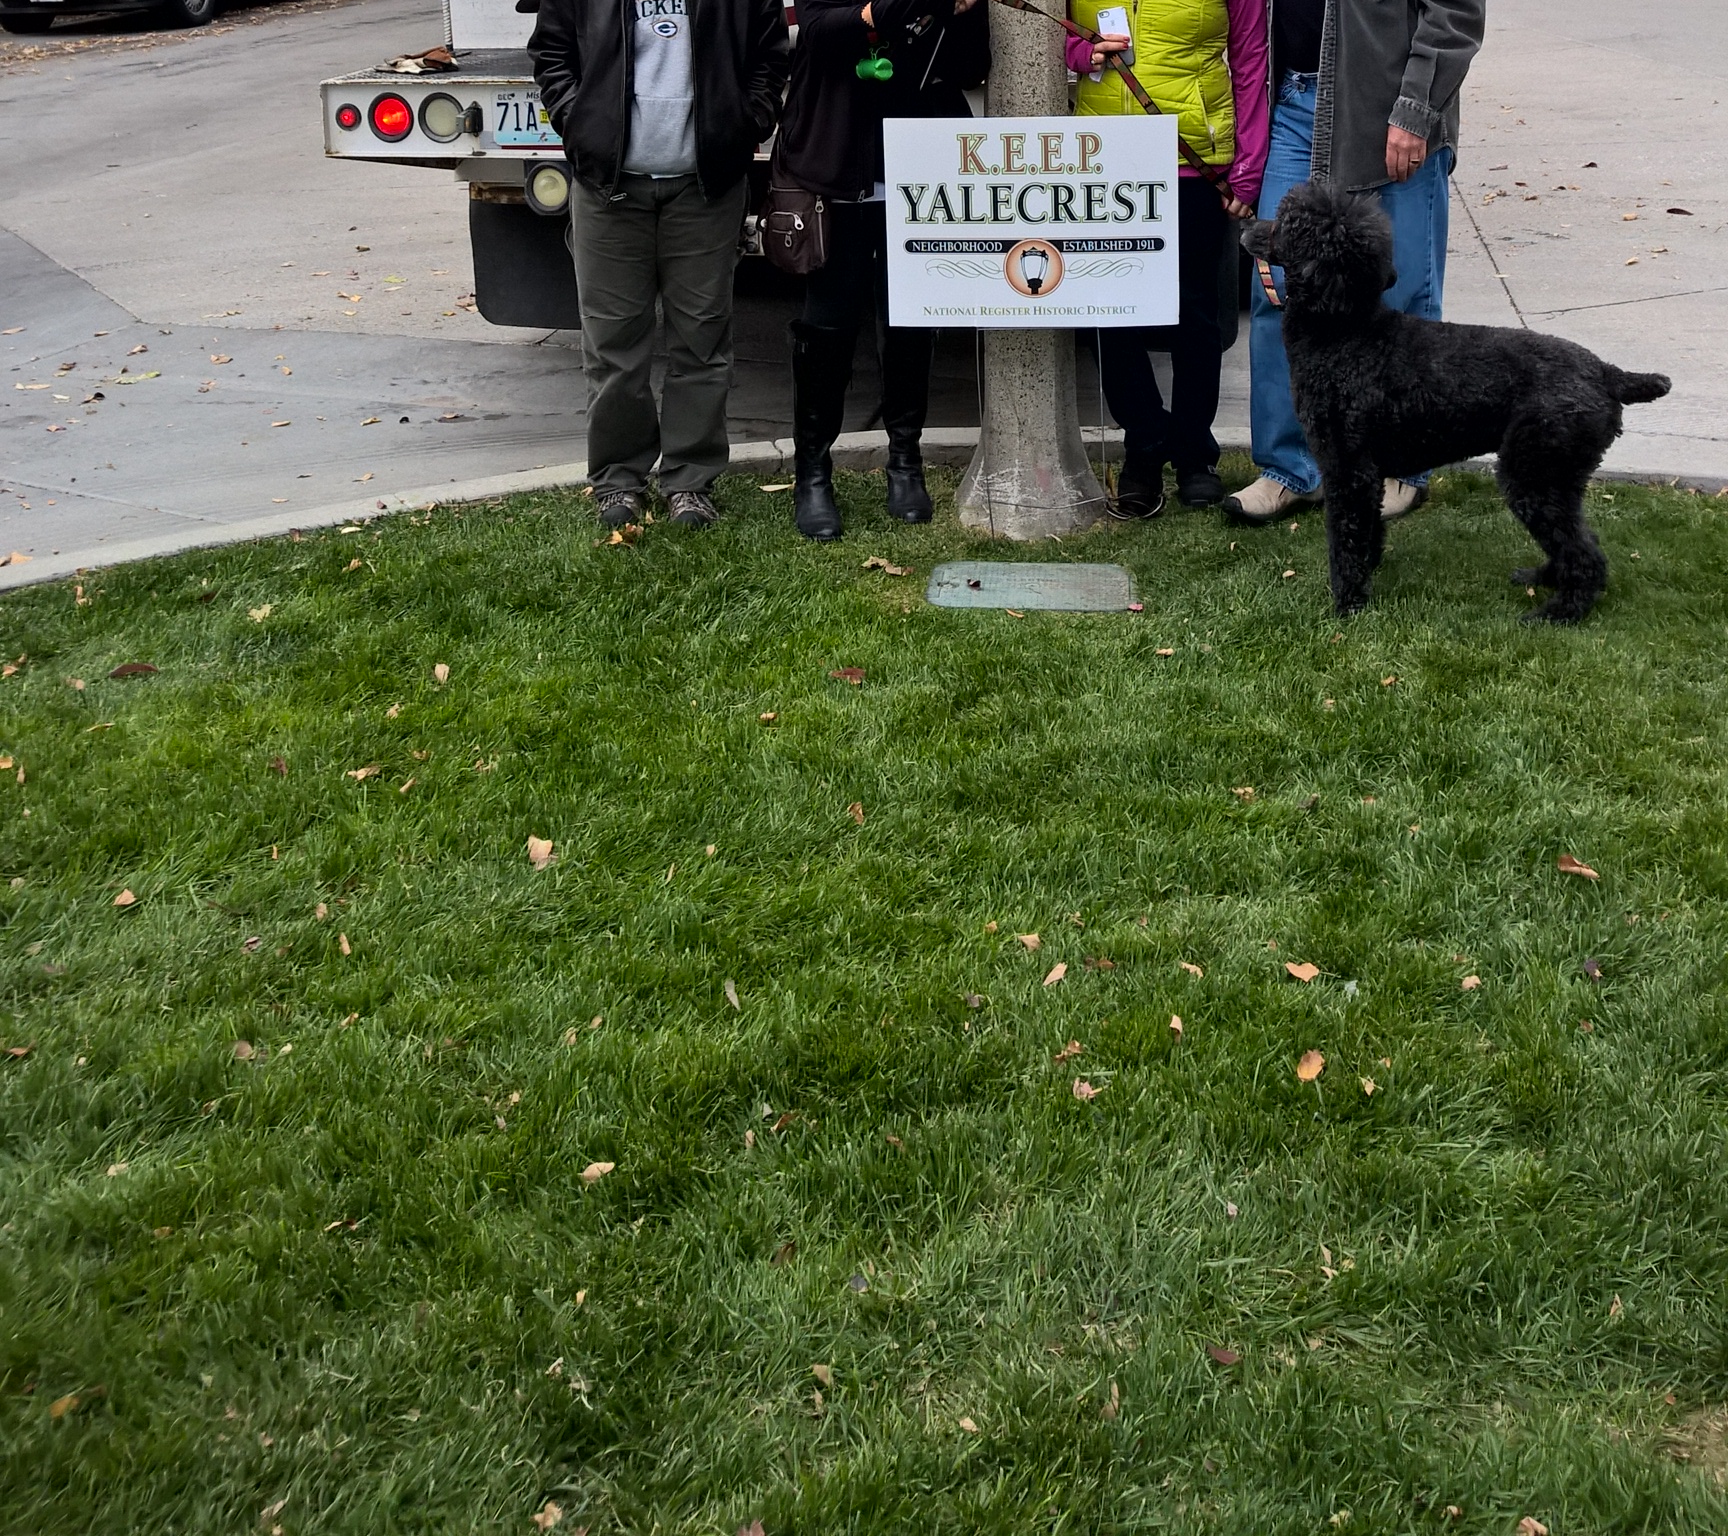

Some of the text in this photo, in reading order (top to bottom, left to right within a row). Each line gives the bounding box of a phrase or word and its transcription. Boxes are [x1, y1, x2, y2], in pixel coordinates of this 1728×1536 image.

[956, 132, 1104, 176] K.E.E.P.
[897, 180, 1168, 225] YALECREST
[912, 239, 1156, 252] NEIGHBORHOOD ESTABLISHED 1911
